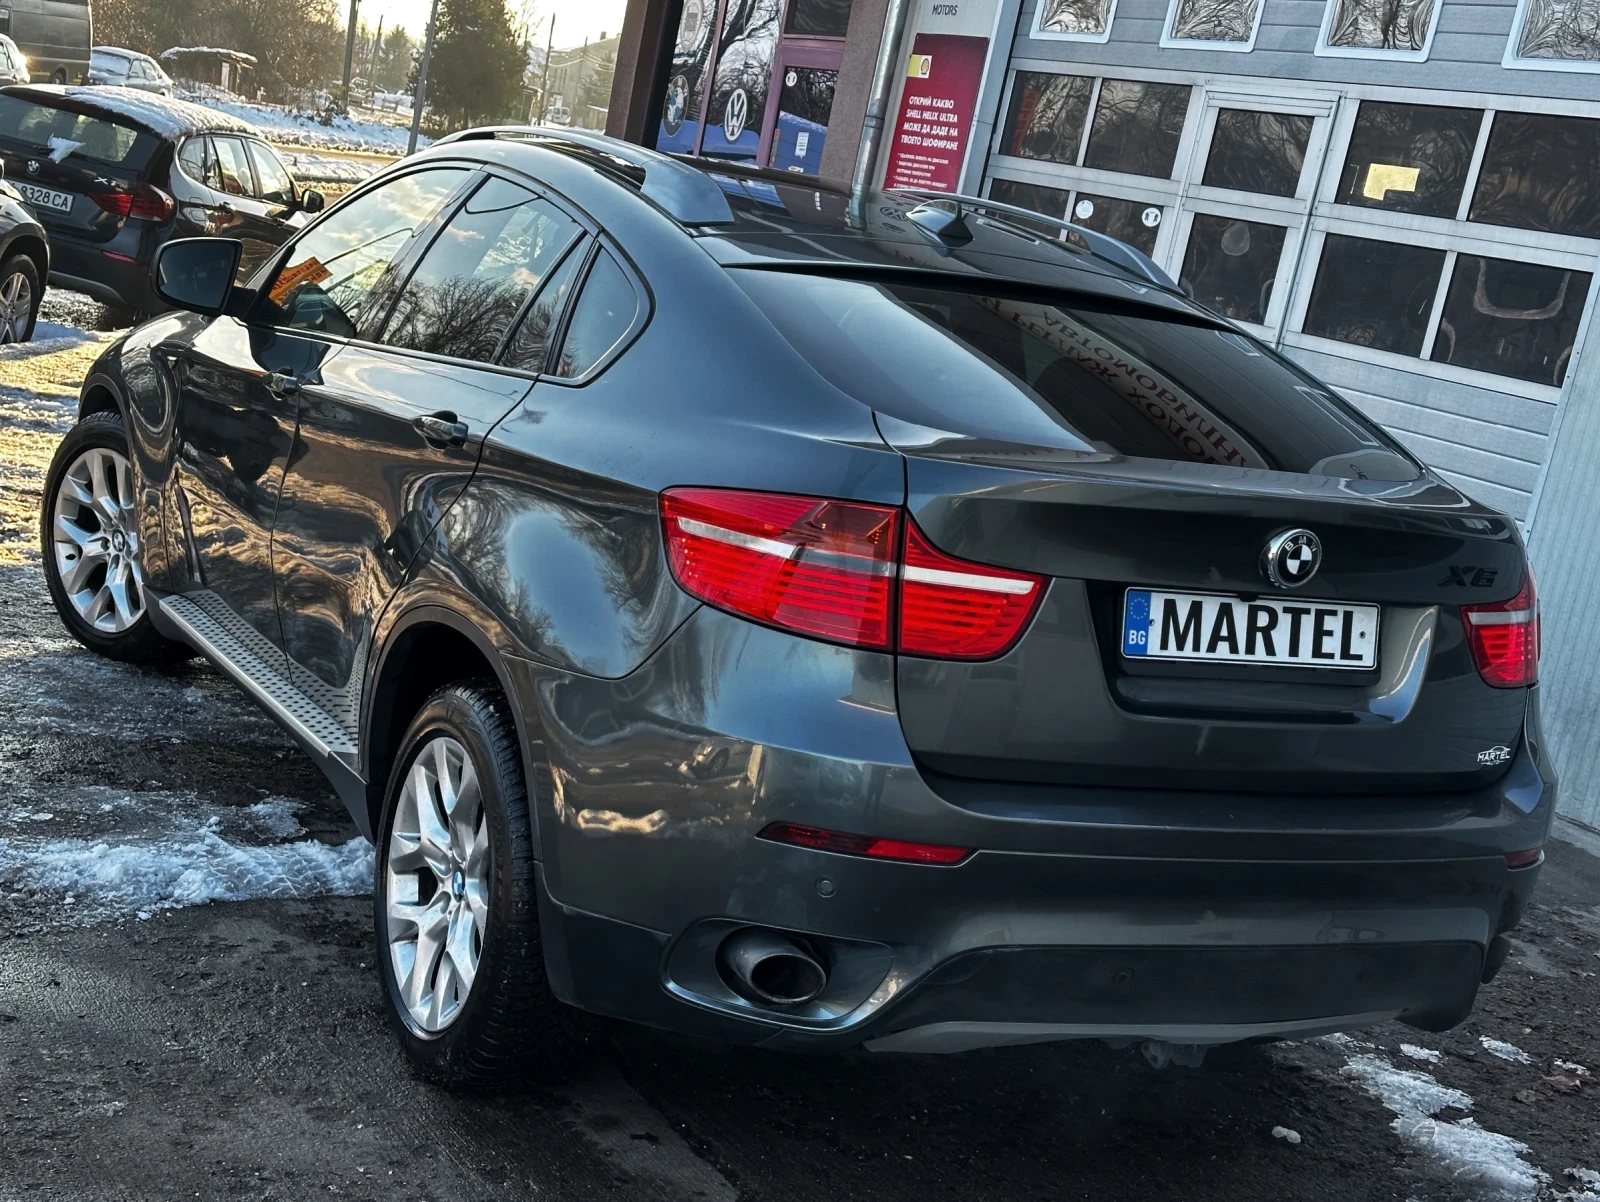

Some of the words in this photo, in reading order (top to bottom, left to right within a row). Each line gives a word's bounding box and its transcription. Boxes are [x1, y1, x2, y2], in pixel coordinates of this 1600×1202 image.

[932, 4, 958, 16] MOTORS
[909, 96, 932, 107] ОТКРИЙ
[932, 98, 954, 109] КАКВО
[906, 109, 922, 119] SHELL
[922, 111, 939, 121] HELIX
[939, 112, 958, 123] ULTRA
[903, 122, 921, 132] МОЖЕ
[921, 124, 931, 134] ДА
[931, 126, 948, 136] ДАДЕ
[949, 128, 958, 137] НА
[901, 135, 922, 146] ТВОЕТО
[922, 137, 959, 151] ШОФИРАНЕ
[52, 194, 69, 210] CA
[1285, 535, 1317, 552] BMW
[1436, 565, 1499, 588] X6
[1128, 629, 1146, 645] BG
[1159, 598, 1364, 661] MARTEL
[1477, 750, 1511, 762] MARTEL
